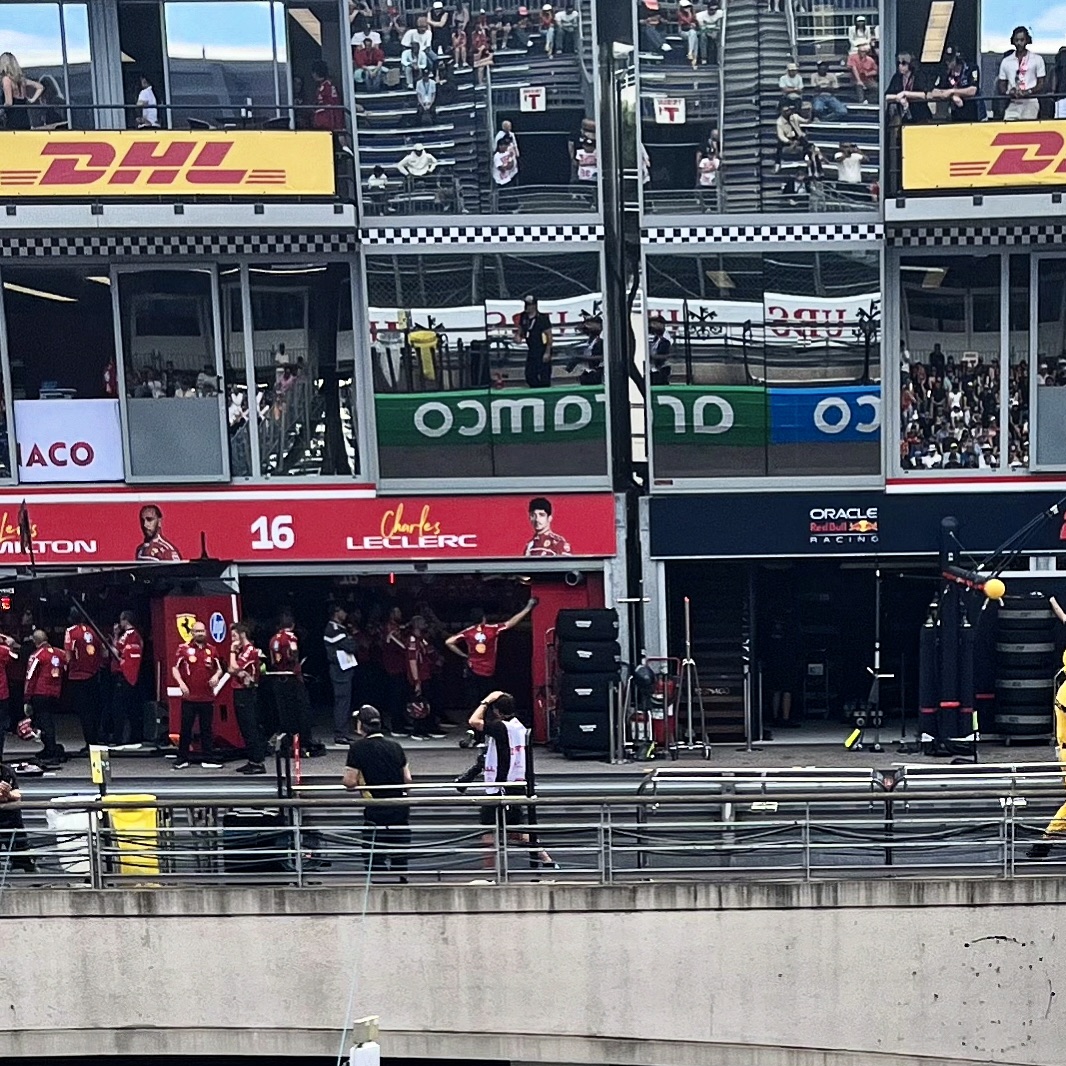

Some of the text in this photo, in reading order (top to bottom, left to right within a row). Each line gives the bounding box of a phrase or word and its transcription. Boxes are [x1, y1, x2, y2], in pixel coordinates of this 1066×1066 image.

[39, 141, 249, 185] DHL
[17, 441, 95, 468] ACO
[380, 503, 441, 539] Charles
[810, 507, 878, 519] ORACLE
[251, 514, 296, 550] 16
[347, 534, 478, 550] LECLERC
